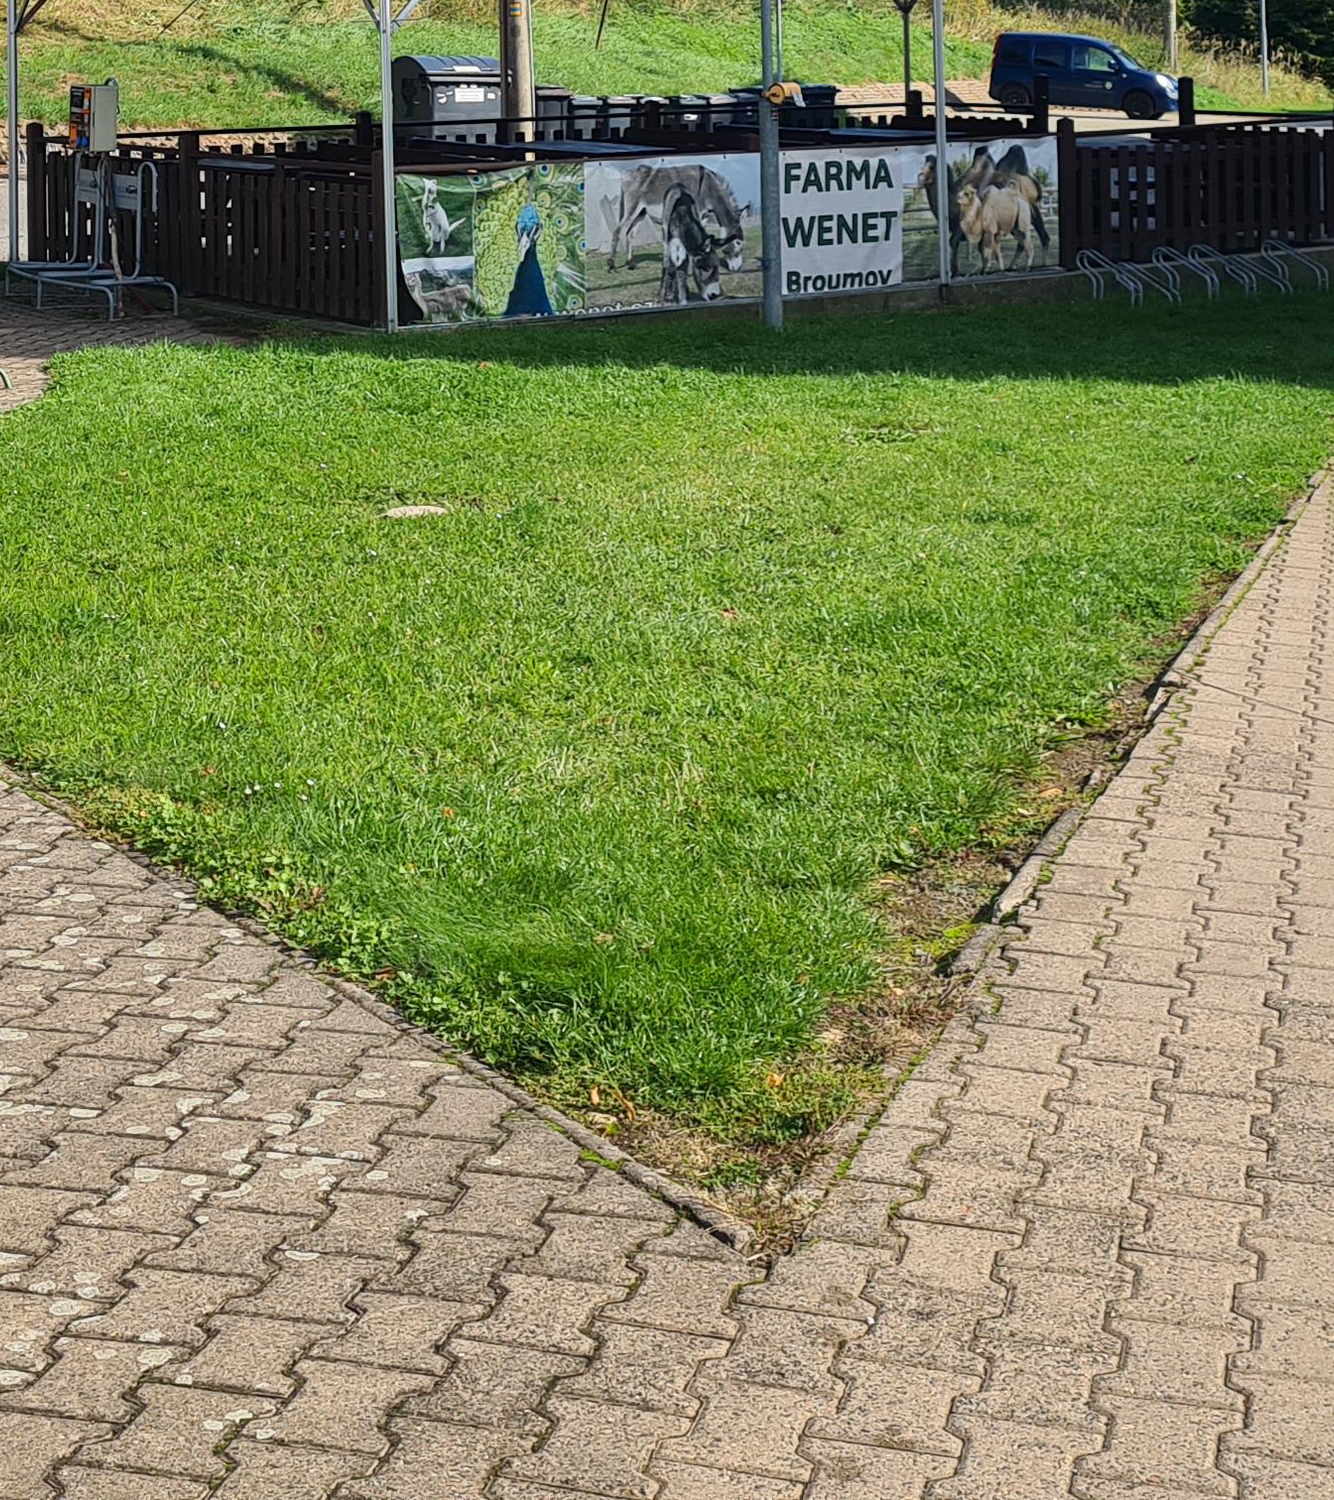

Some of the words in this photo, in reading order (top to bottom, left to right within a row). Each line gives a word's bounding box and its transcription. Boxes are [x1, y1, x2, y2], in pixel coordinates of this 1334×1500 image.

[784, 158, 894, 194] FARMA
[782, 211, 898, 248] WENET
[786, 269, 893, 294] Broumov
